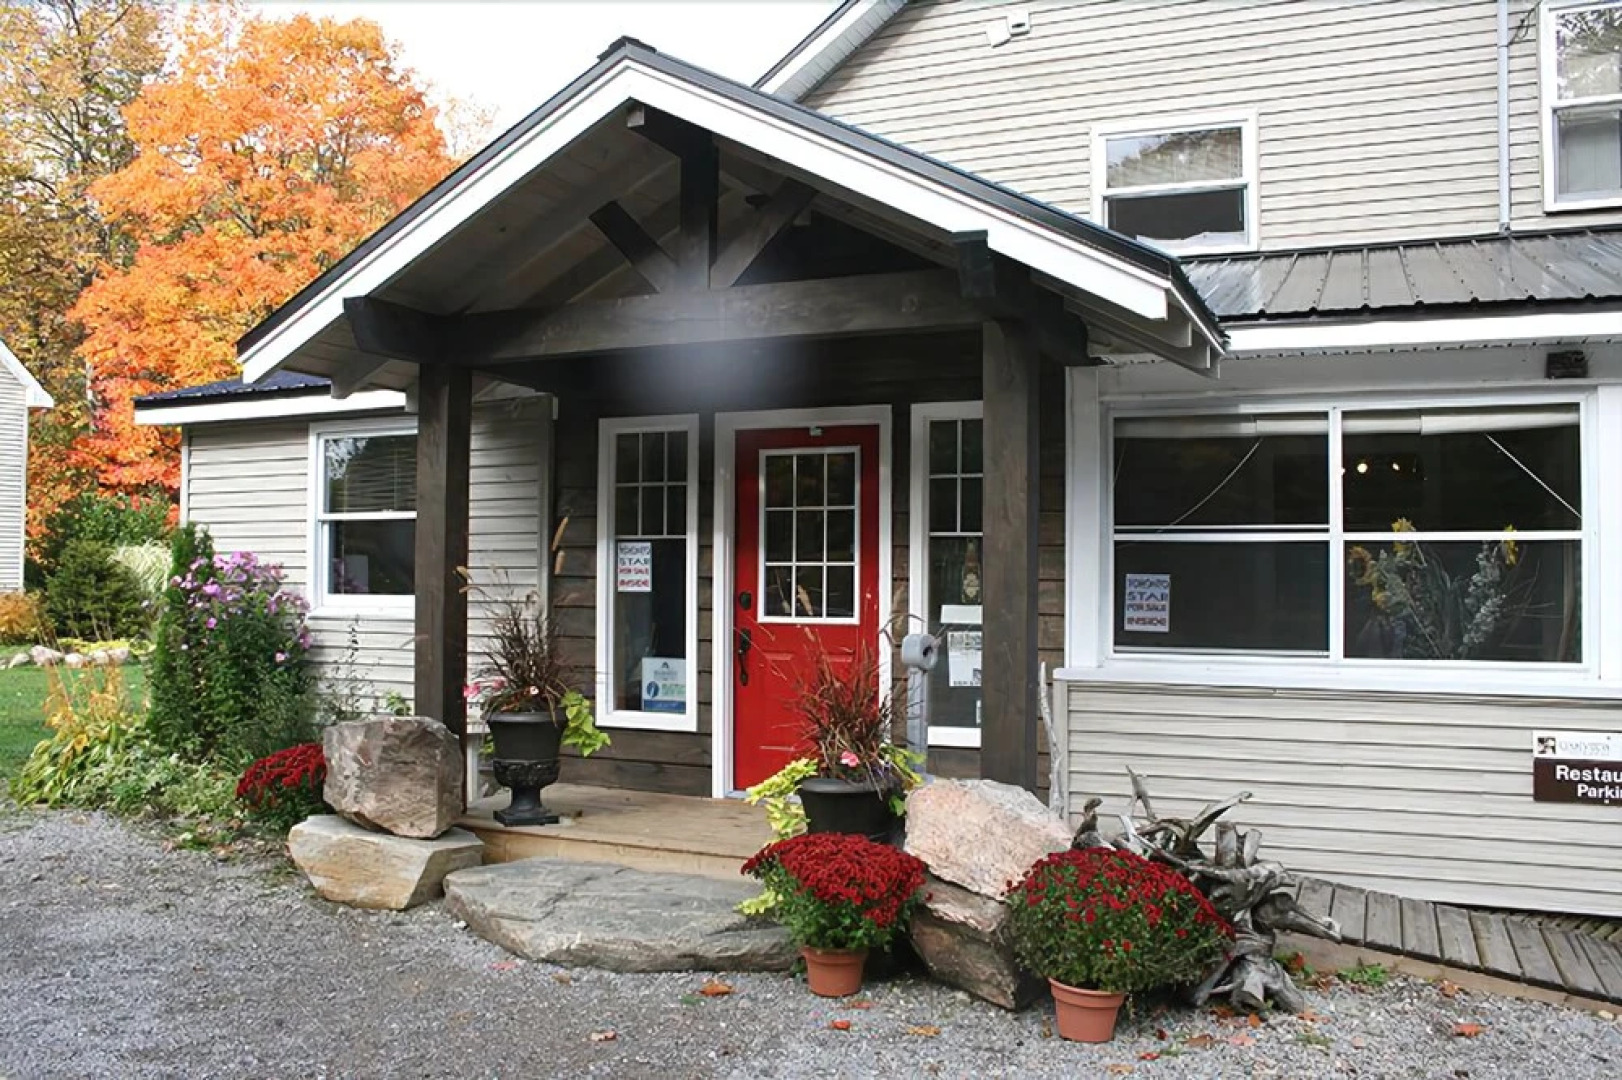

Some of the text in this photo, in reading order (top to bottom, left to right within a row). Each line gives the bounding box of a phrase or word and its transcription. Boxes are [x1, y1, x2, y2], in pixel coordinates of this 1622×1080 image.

[620, 557, 650, 566] STAR
[1128, 591, 1168, 602] STAR
[1556, 764, 1622, 783] Restau
[1577, 783, 1622, 799] Parki
